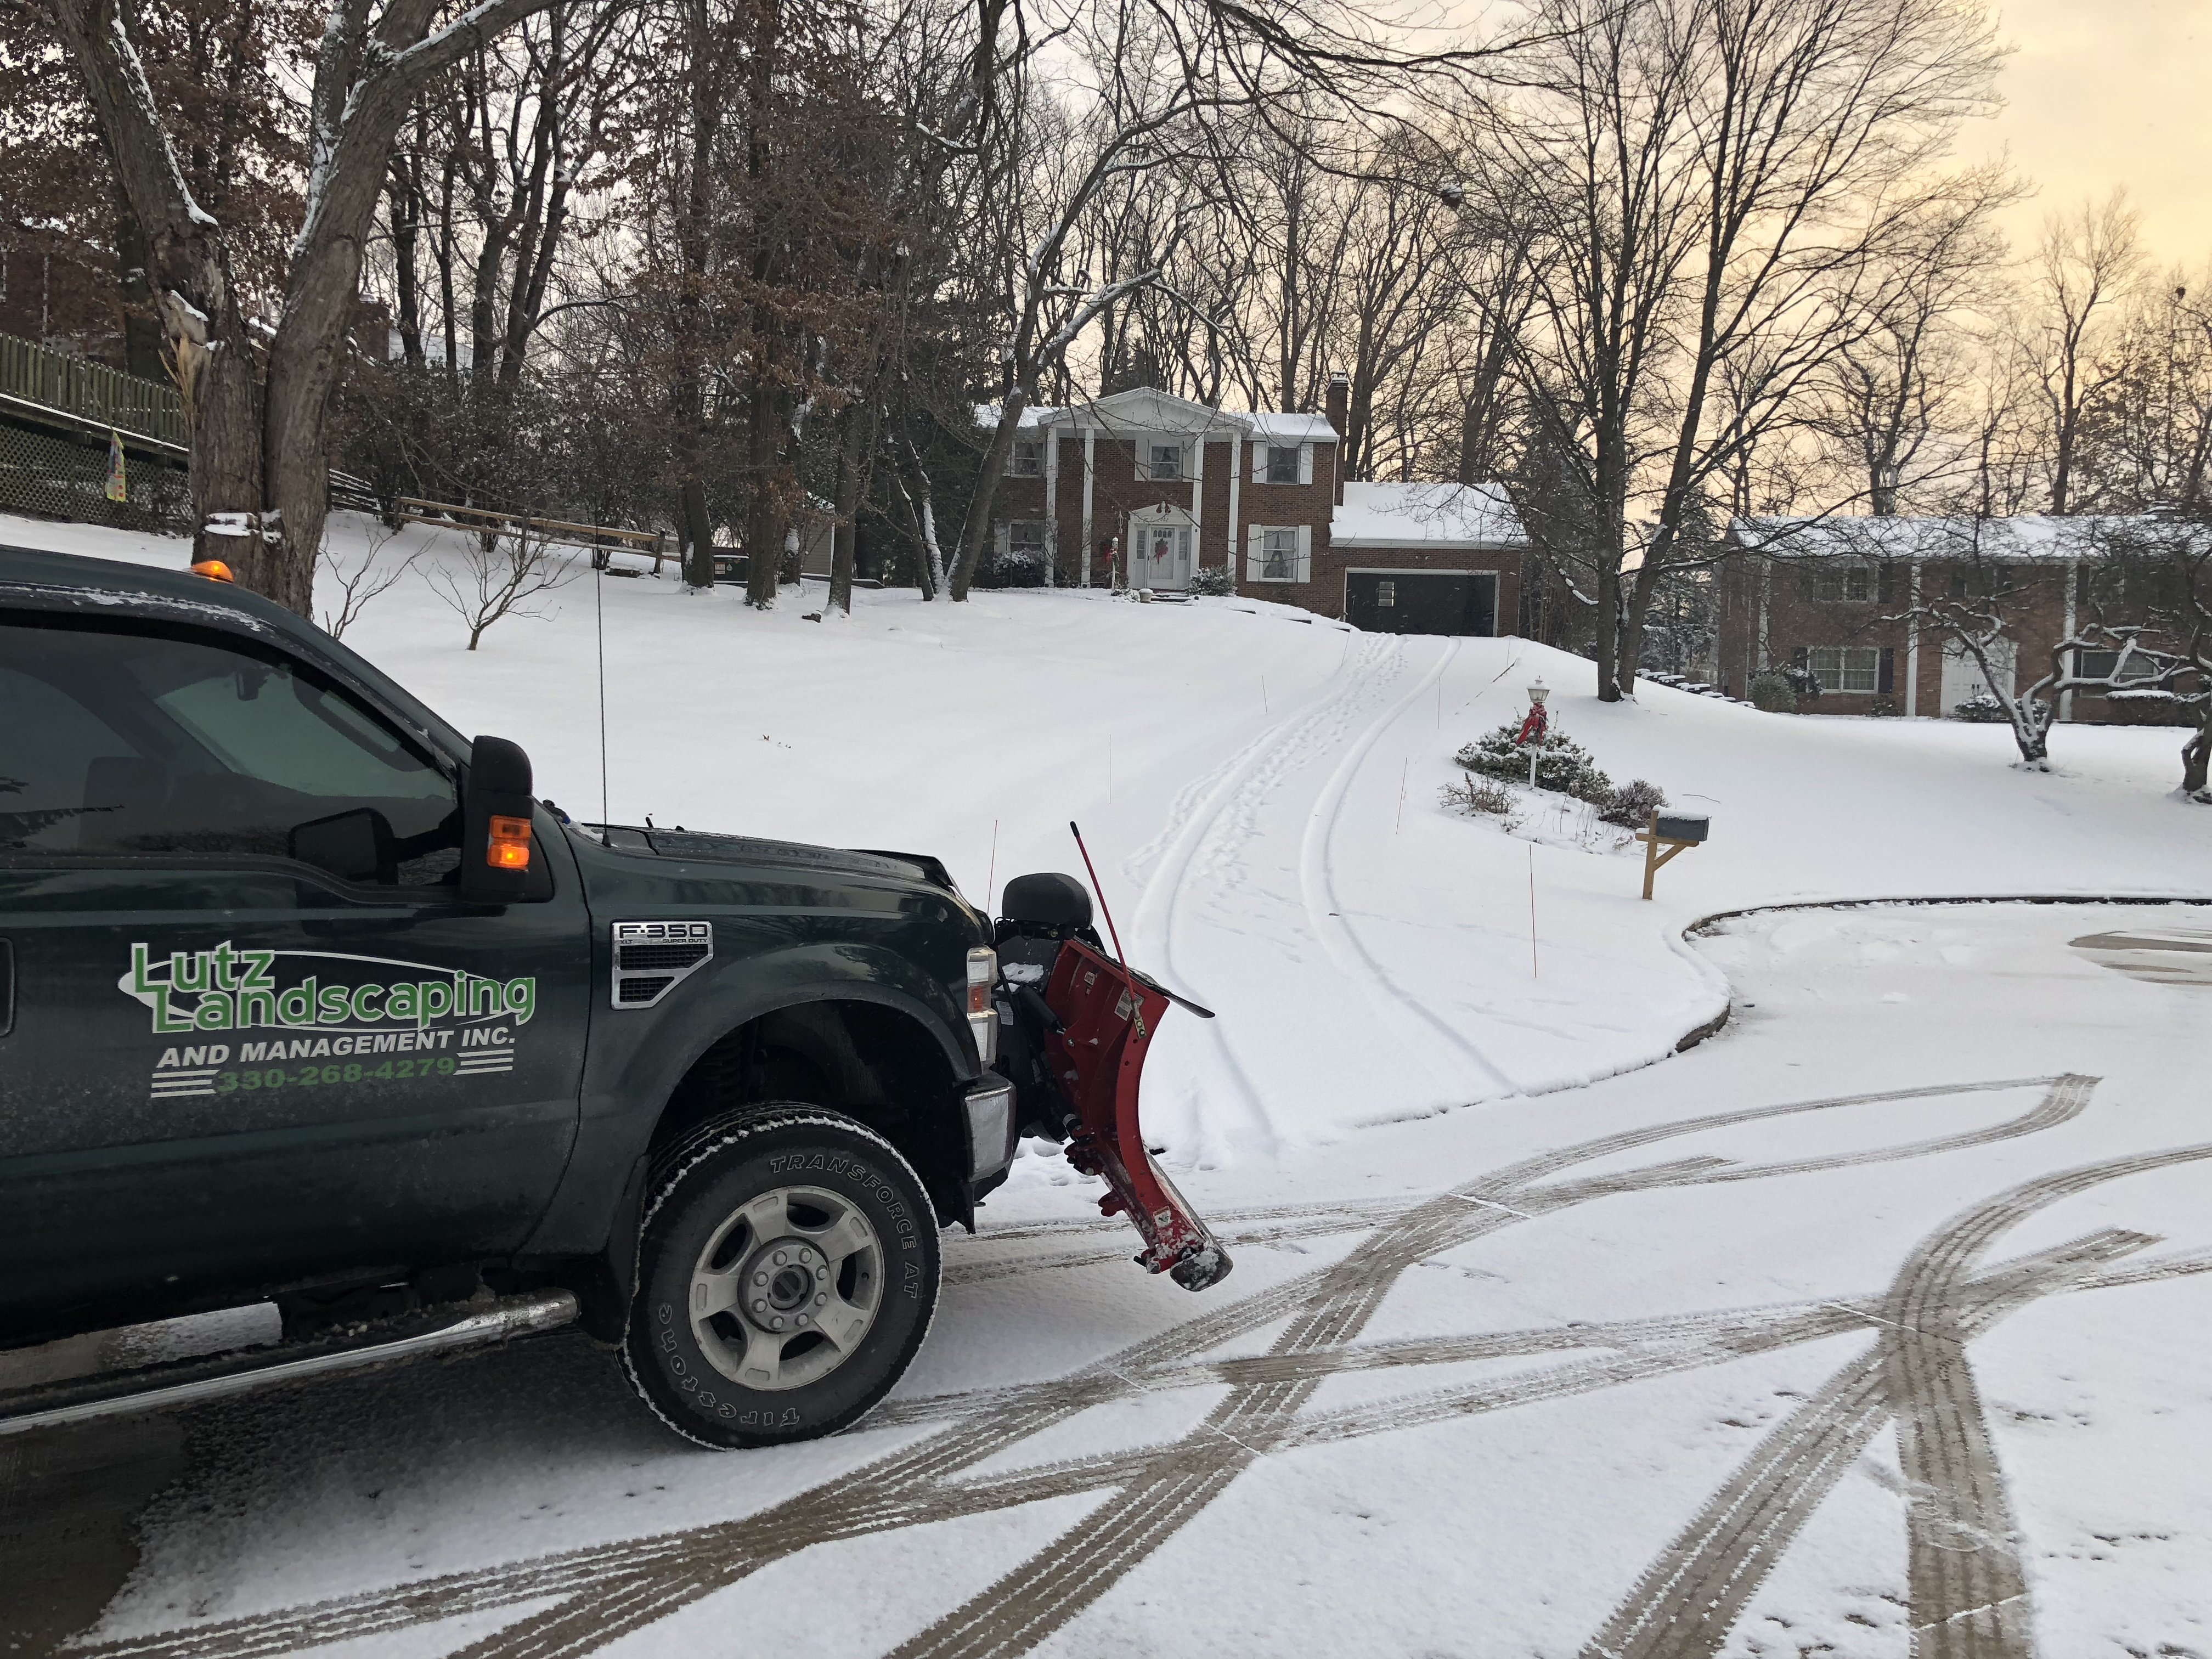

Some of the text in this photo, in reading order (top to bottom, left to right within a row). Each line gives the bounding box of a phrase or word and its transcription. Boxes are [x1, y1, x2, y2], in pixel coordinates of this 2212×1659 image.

[619, 924, 708, 939] F-350
[131, 940, 275, 994] Lutz
[151, 970, 535, 1033] Landscaping
[156, 1026, 516, 1068] AND MANAGEMENT INC.
[218, 1056, 455, 1093] 330-268-4279
[770, 1154, 920, 1299] TRANSFORCE AT
